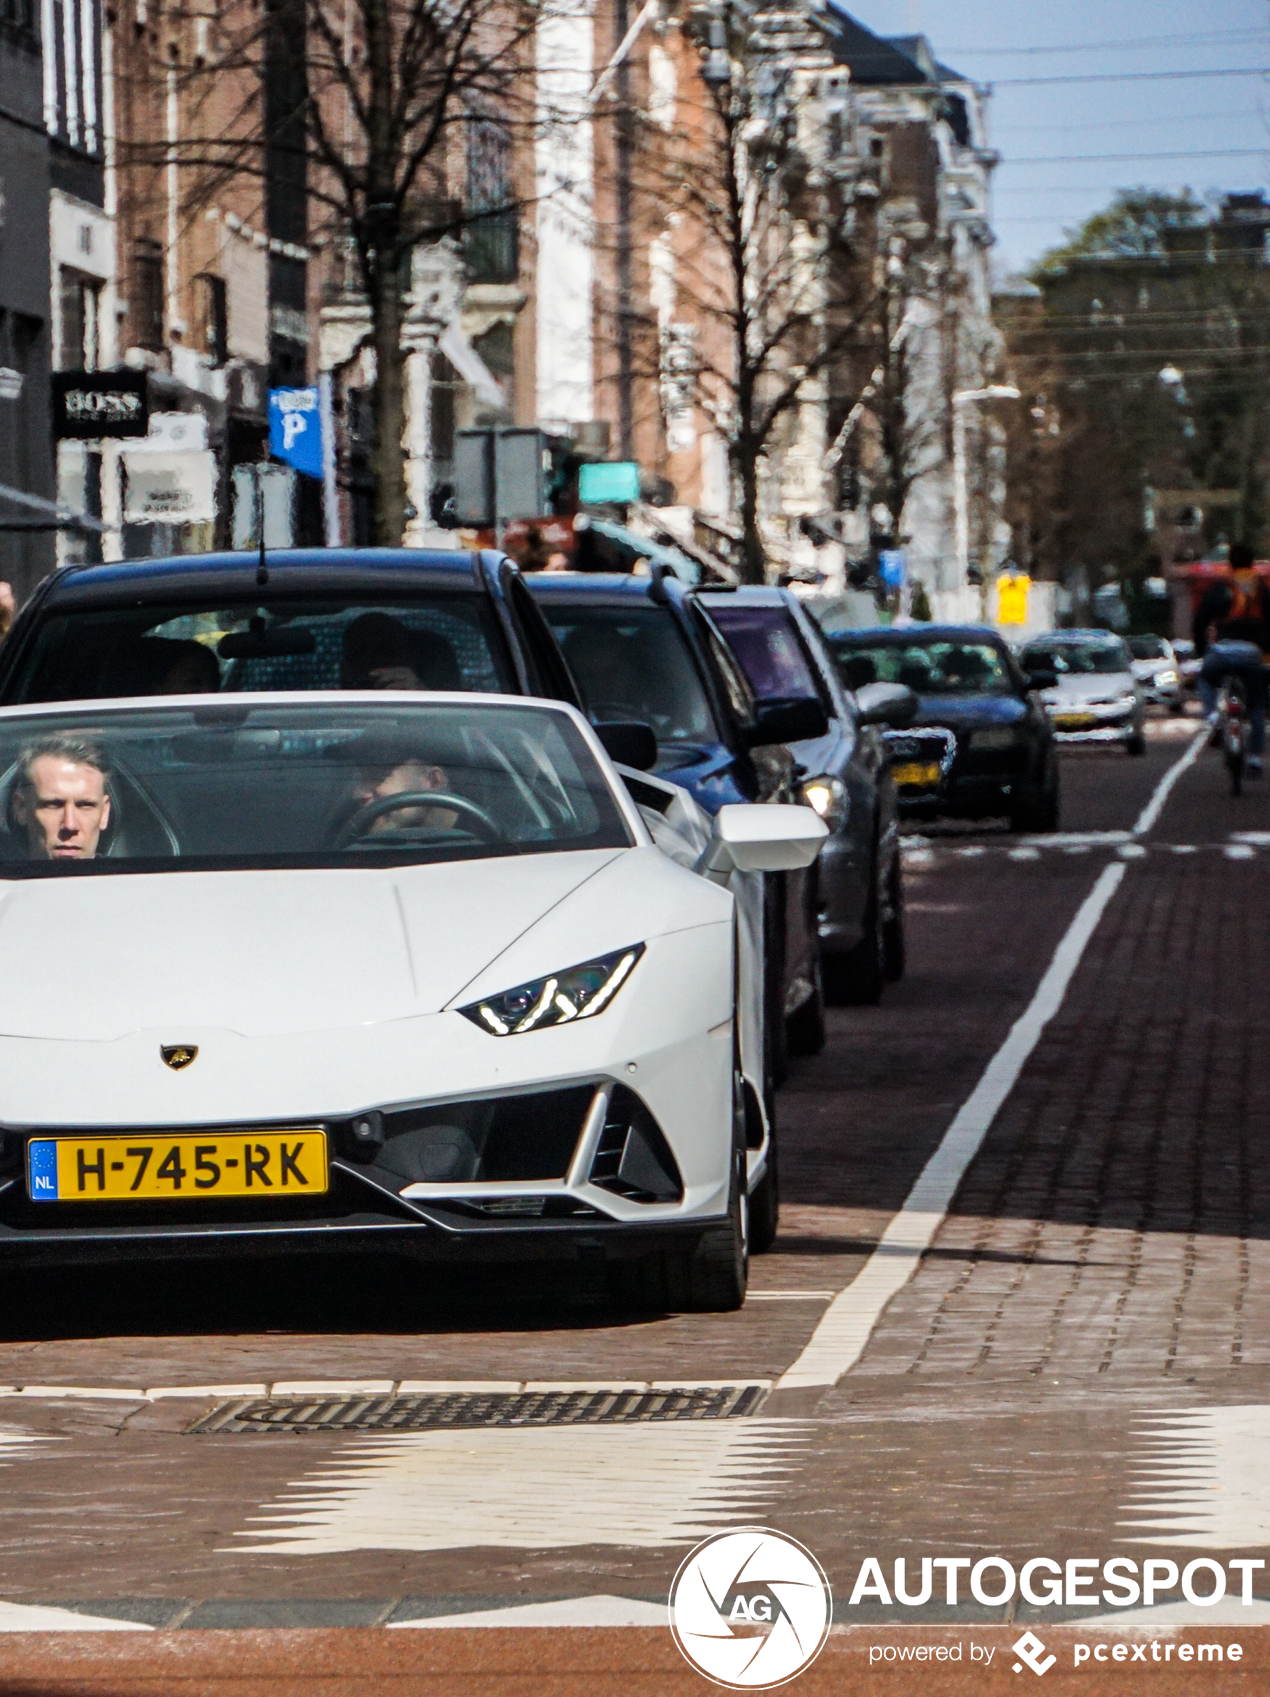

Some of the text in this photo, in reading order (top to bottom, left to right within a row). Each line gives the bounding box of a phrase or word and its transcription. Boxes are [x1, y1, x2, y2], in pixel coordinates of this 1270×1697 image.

[281, 412, 307, 450] P
[35, 1176, 55, 1190] NL
[76, 1142, 310, 1192] H-745-RK
